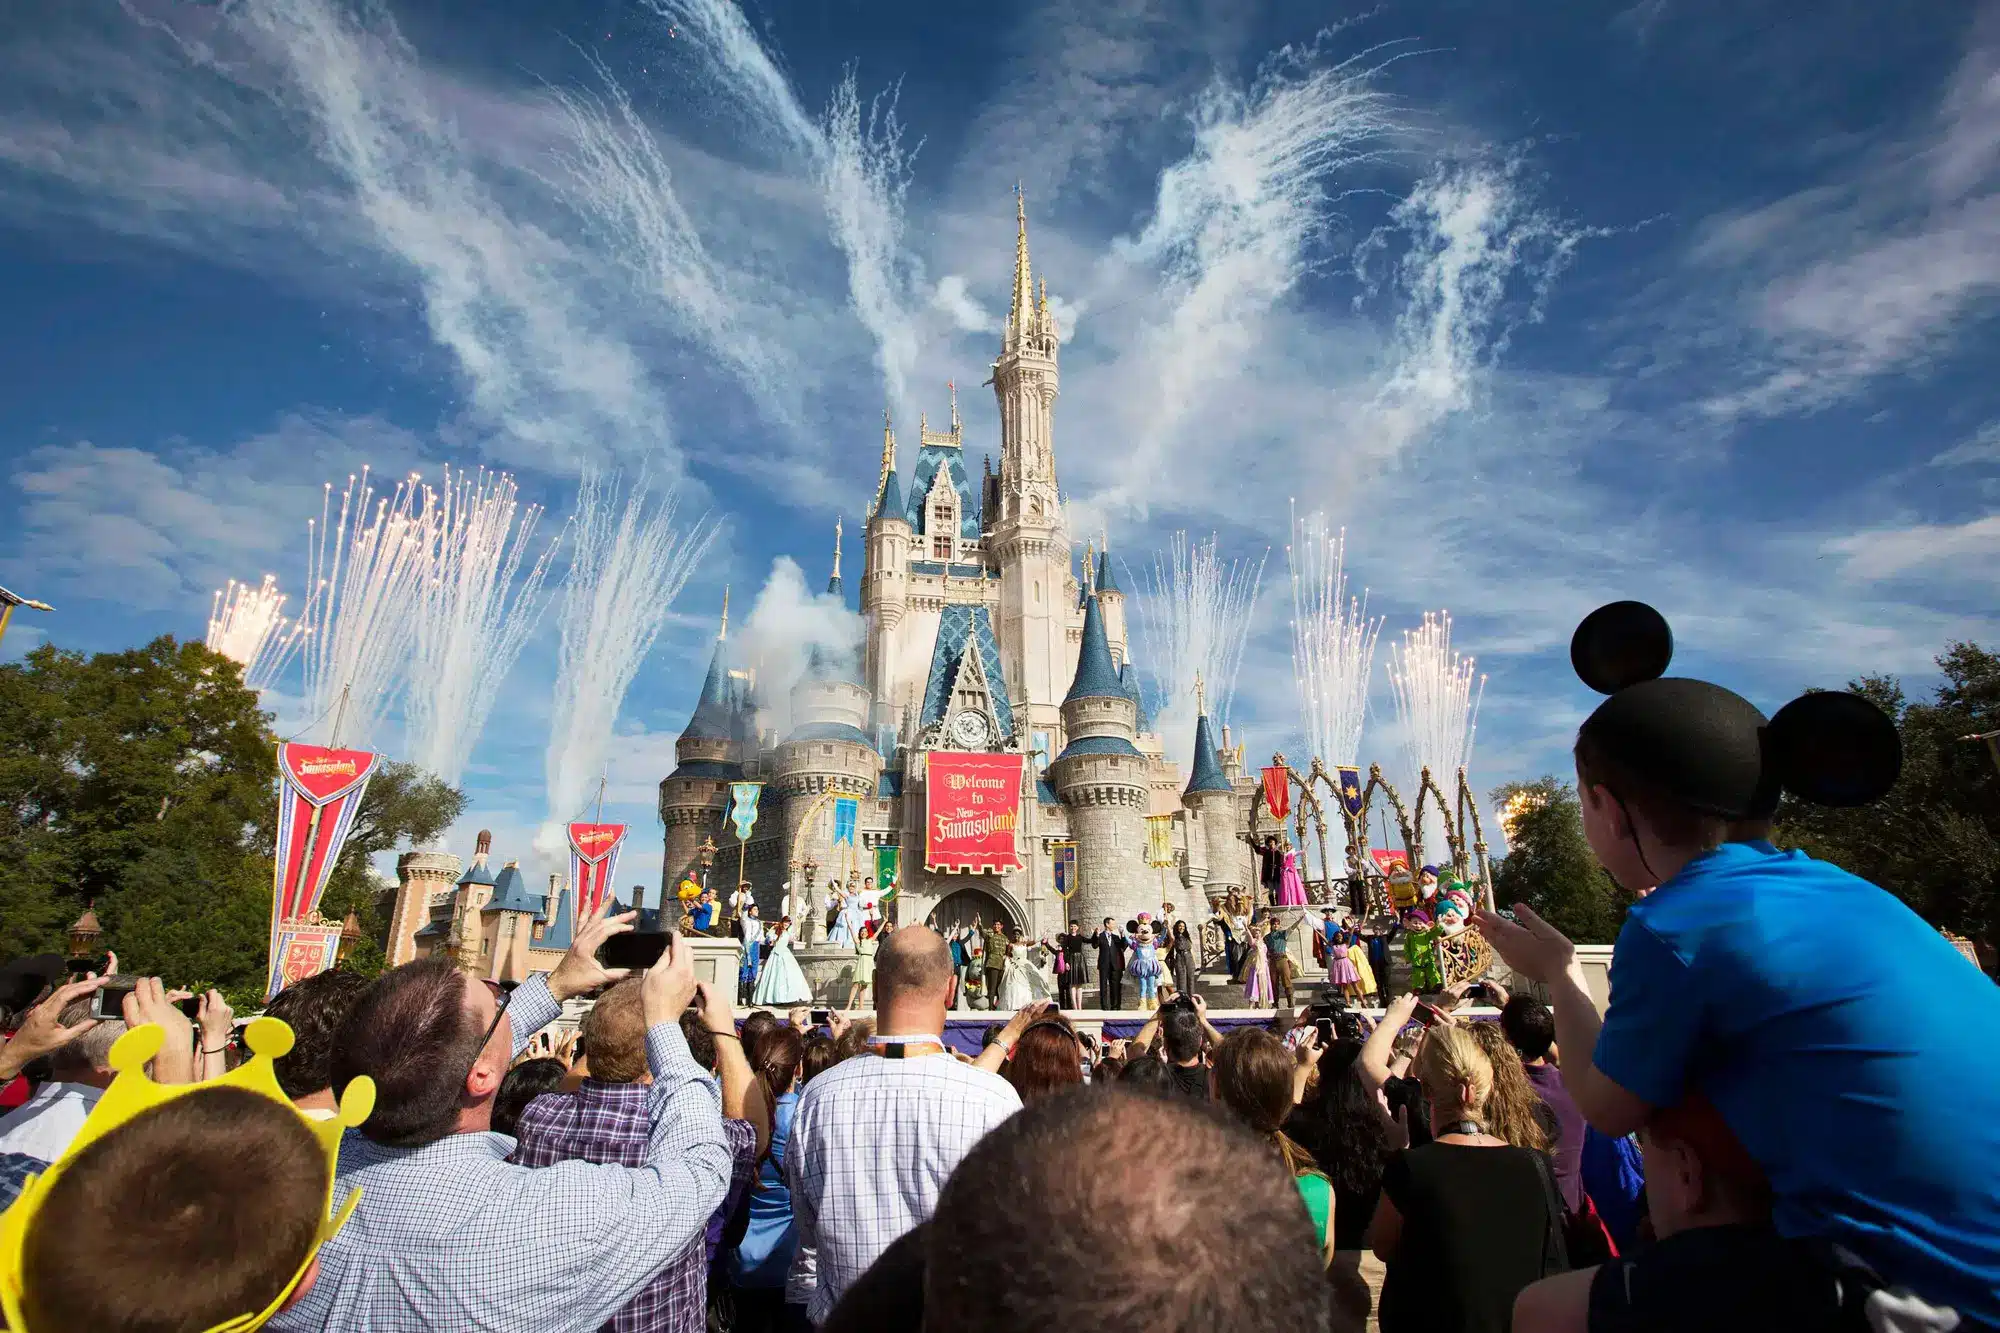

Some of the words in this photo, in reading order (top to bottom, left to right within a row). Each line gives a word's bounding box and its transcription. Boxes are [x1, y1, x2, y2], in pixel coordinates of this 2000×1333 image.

[943, 773, 1006, 789] Welcome
[971, 792, 984, 805] to
[933, 806, 1016, 843] Fantasyland
